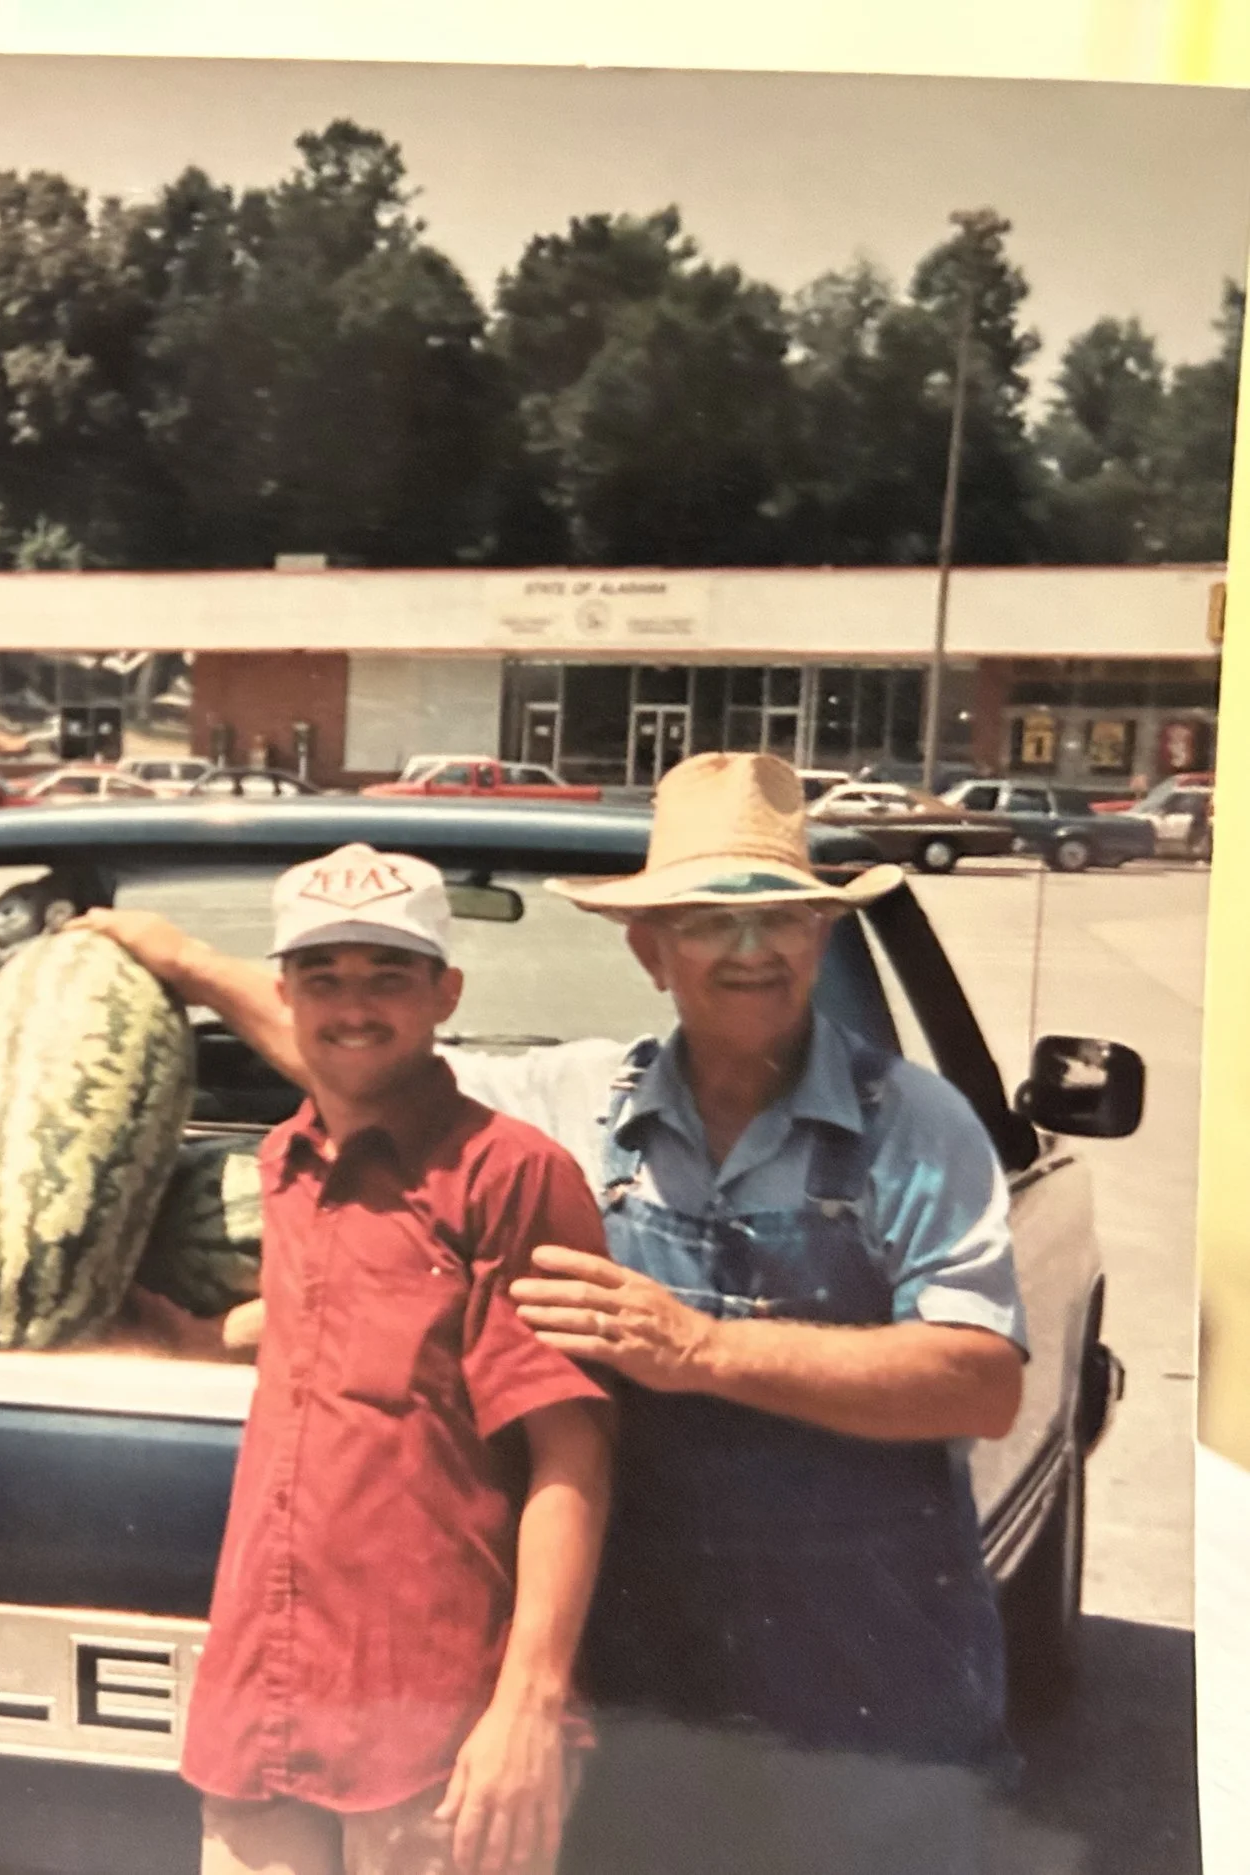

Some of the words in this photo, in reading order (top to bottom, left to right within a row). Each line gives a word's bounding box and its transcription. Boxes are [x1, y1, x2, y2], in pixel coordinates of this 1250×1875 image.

[524, 581, 566, 596] STATE
[572, 581, 594, 596] OF
[600, 582, 667, 595] ALABAMA
